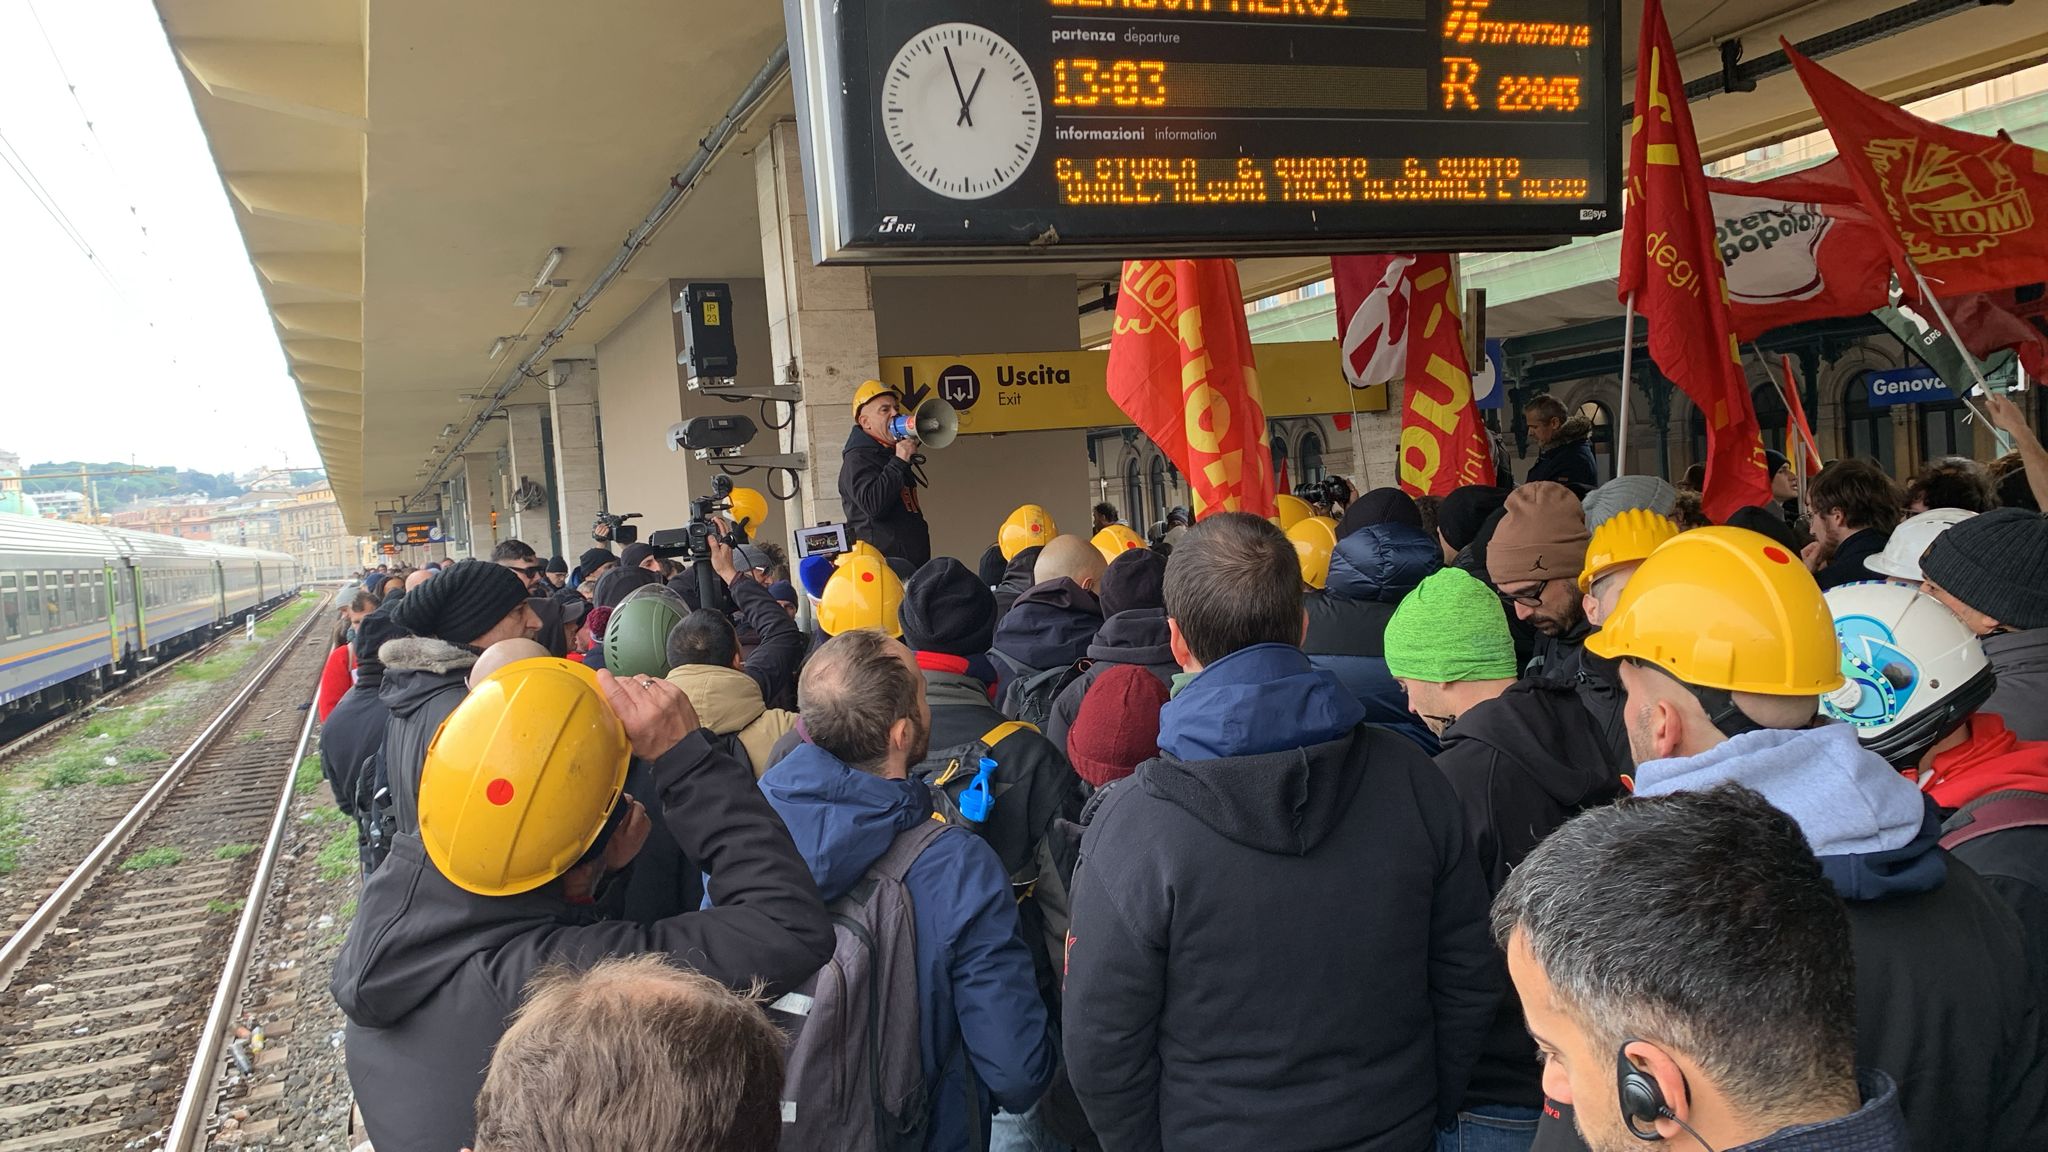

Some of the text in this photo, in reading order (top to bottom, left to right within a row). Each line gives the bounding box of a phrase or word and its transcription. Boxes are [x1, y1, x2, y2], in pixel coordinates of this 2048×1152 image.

[1052, 27, 1180, 45] partenza departure
[1054, 59, 1165, 105] 13:03
[1441, 57, 1479, 110] R
[1056, 126, 1217, 140] informazioni information
[1581, 209, 1607, 220] aesys
[1930, 202, 2023, 233] FIOM
[896, 223, 916, 233] RFI
[706, 303, 716, 312] IP
[706, 314, 718, 323] 23
[996, 364, 1071, 387] Uscita
[1872, 376, 1947, 396] Genova
[998, 392, 1022, 406] Exit
